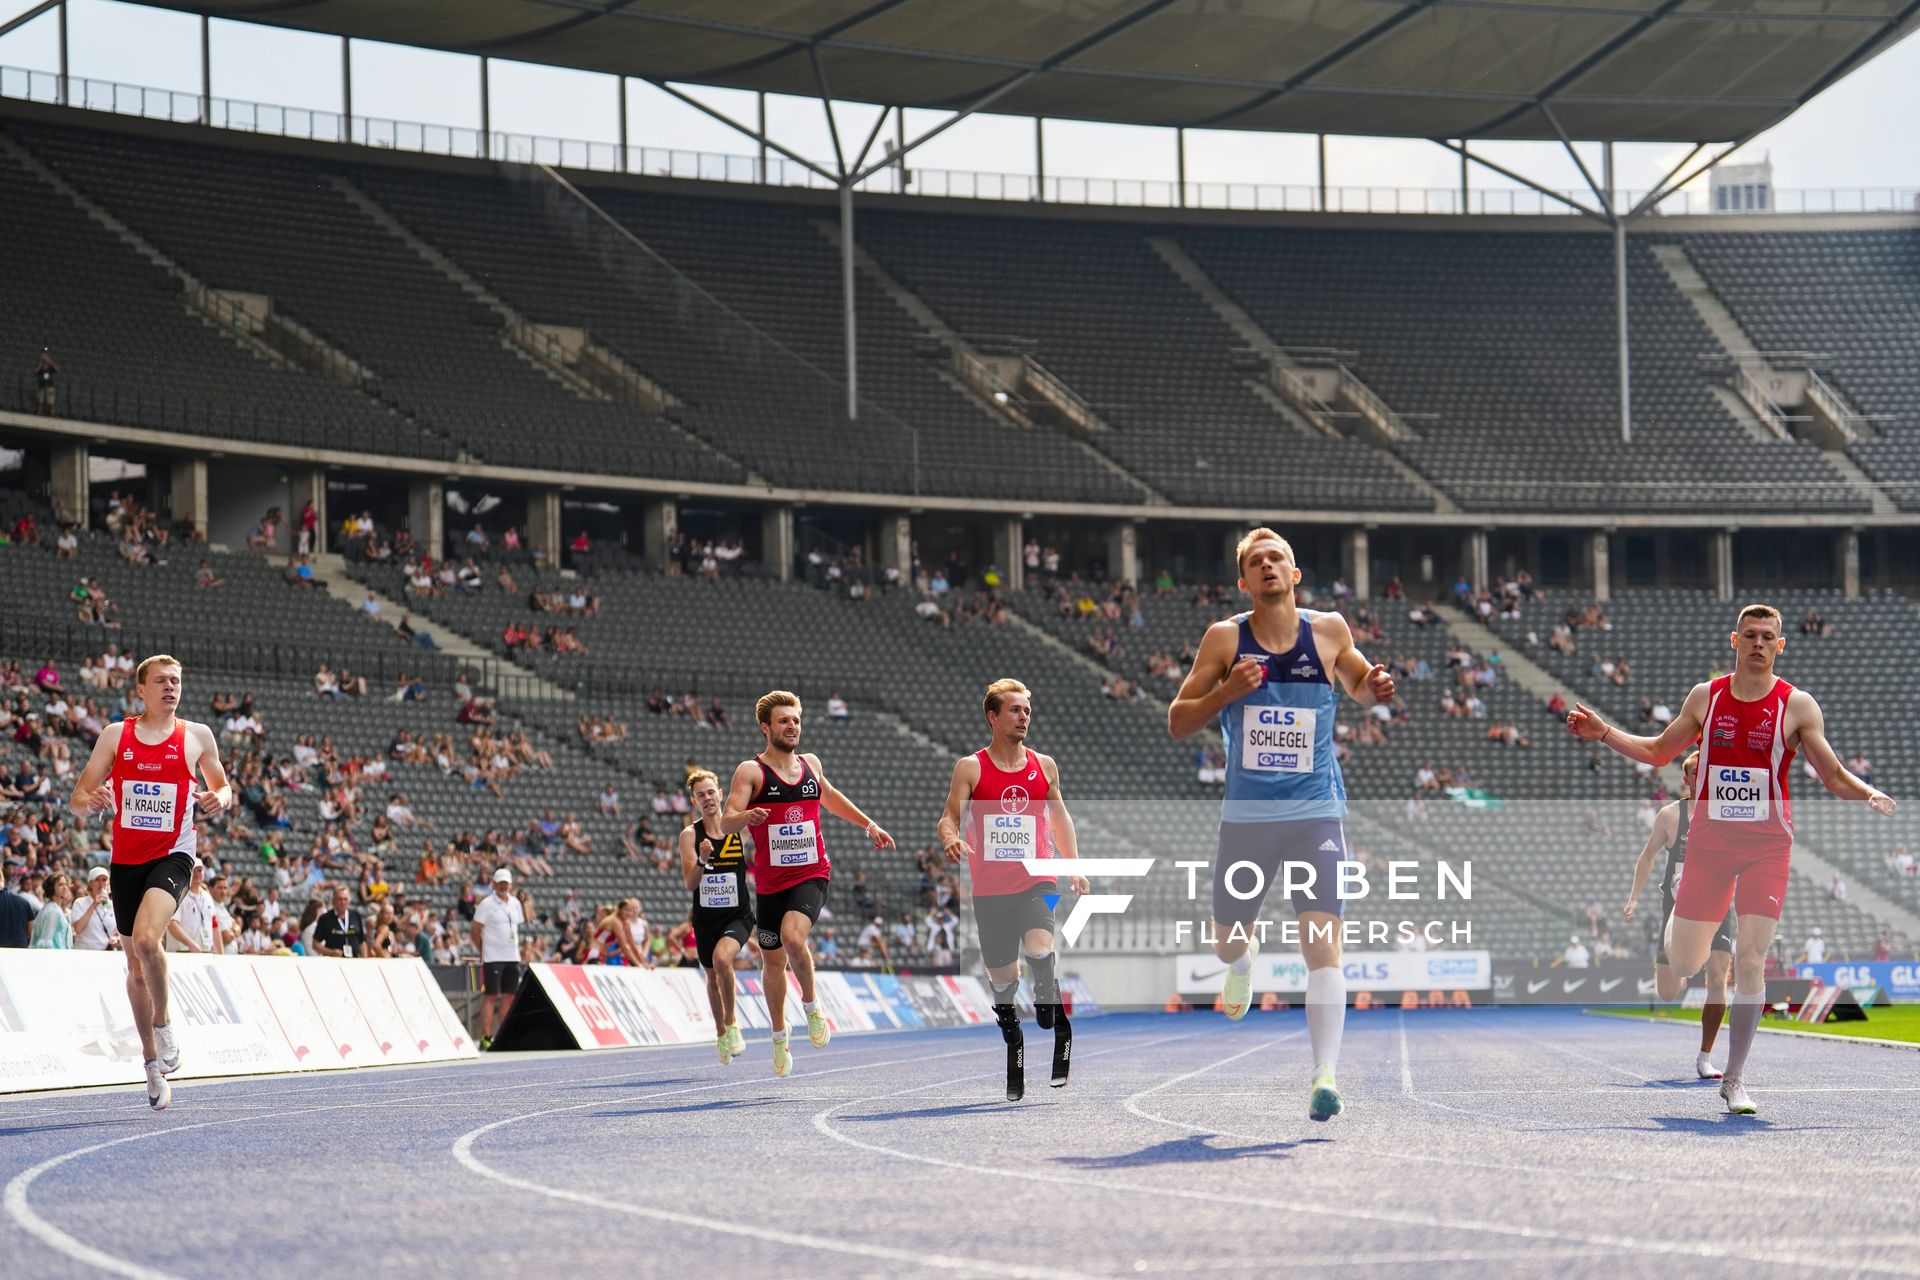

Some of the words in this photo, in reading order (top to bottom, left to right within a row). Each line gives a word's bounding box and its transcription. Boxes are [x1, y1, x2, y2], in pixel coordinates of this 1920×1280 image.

[1250, 729, 1308, 748] SCHLEGEL
[1274, 755, 1297, 763] PLAN
[1716, 785, 1760, 801] KOCH
[125, 798, 133, 811] H.
[135, 799, 172, 813] KRAUSE
[143, 817, 161, 825] PLAN
[771, 837, 815, 851] DAMMERMANN
[990, 831, 1030, 845] FLOORS
[701, 885, 736, 895] LEPPELSACK
